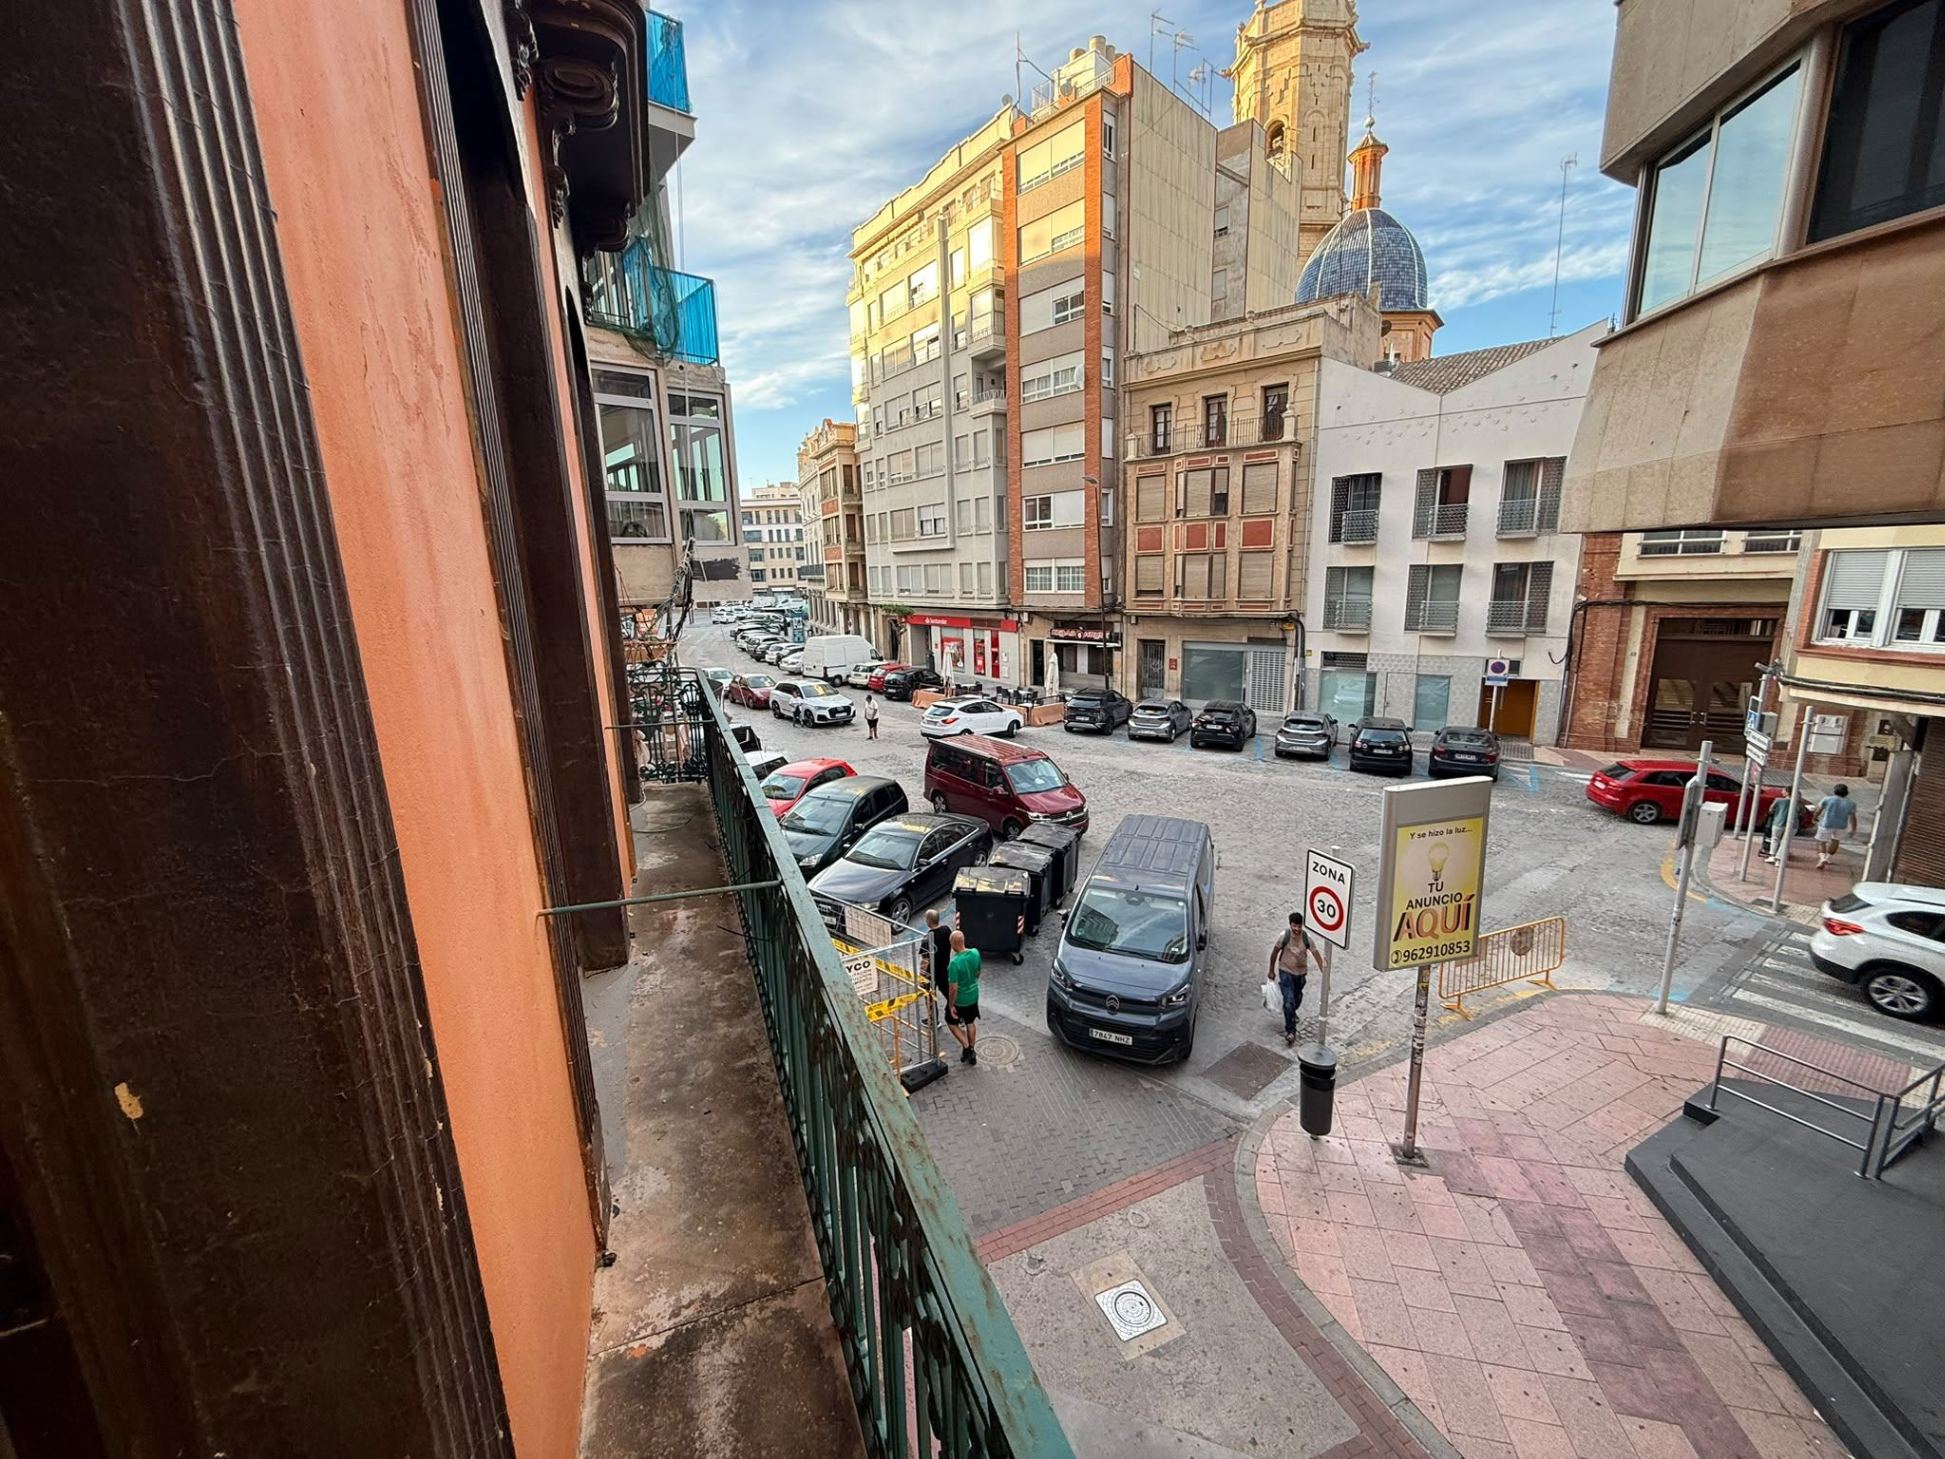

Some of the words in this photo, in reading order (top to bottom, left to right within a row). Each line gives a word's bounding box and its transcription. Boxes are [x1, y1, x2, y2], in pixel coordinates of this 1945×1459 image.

[1312, 861, 1345, 885] ZONA
[1428, 881, 1444, 893] TU
[1317, 899, 1336, 918] 30
[1406, 892, 1463, 910] ANUNCIO
[1393, 894, 1475, 942] AQUÍ
[1403, 940, 1470, 962] 962910853
